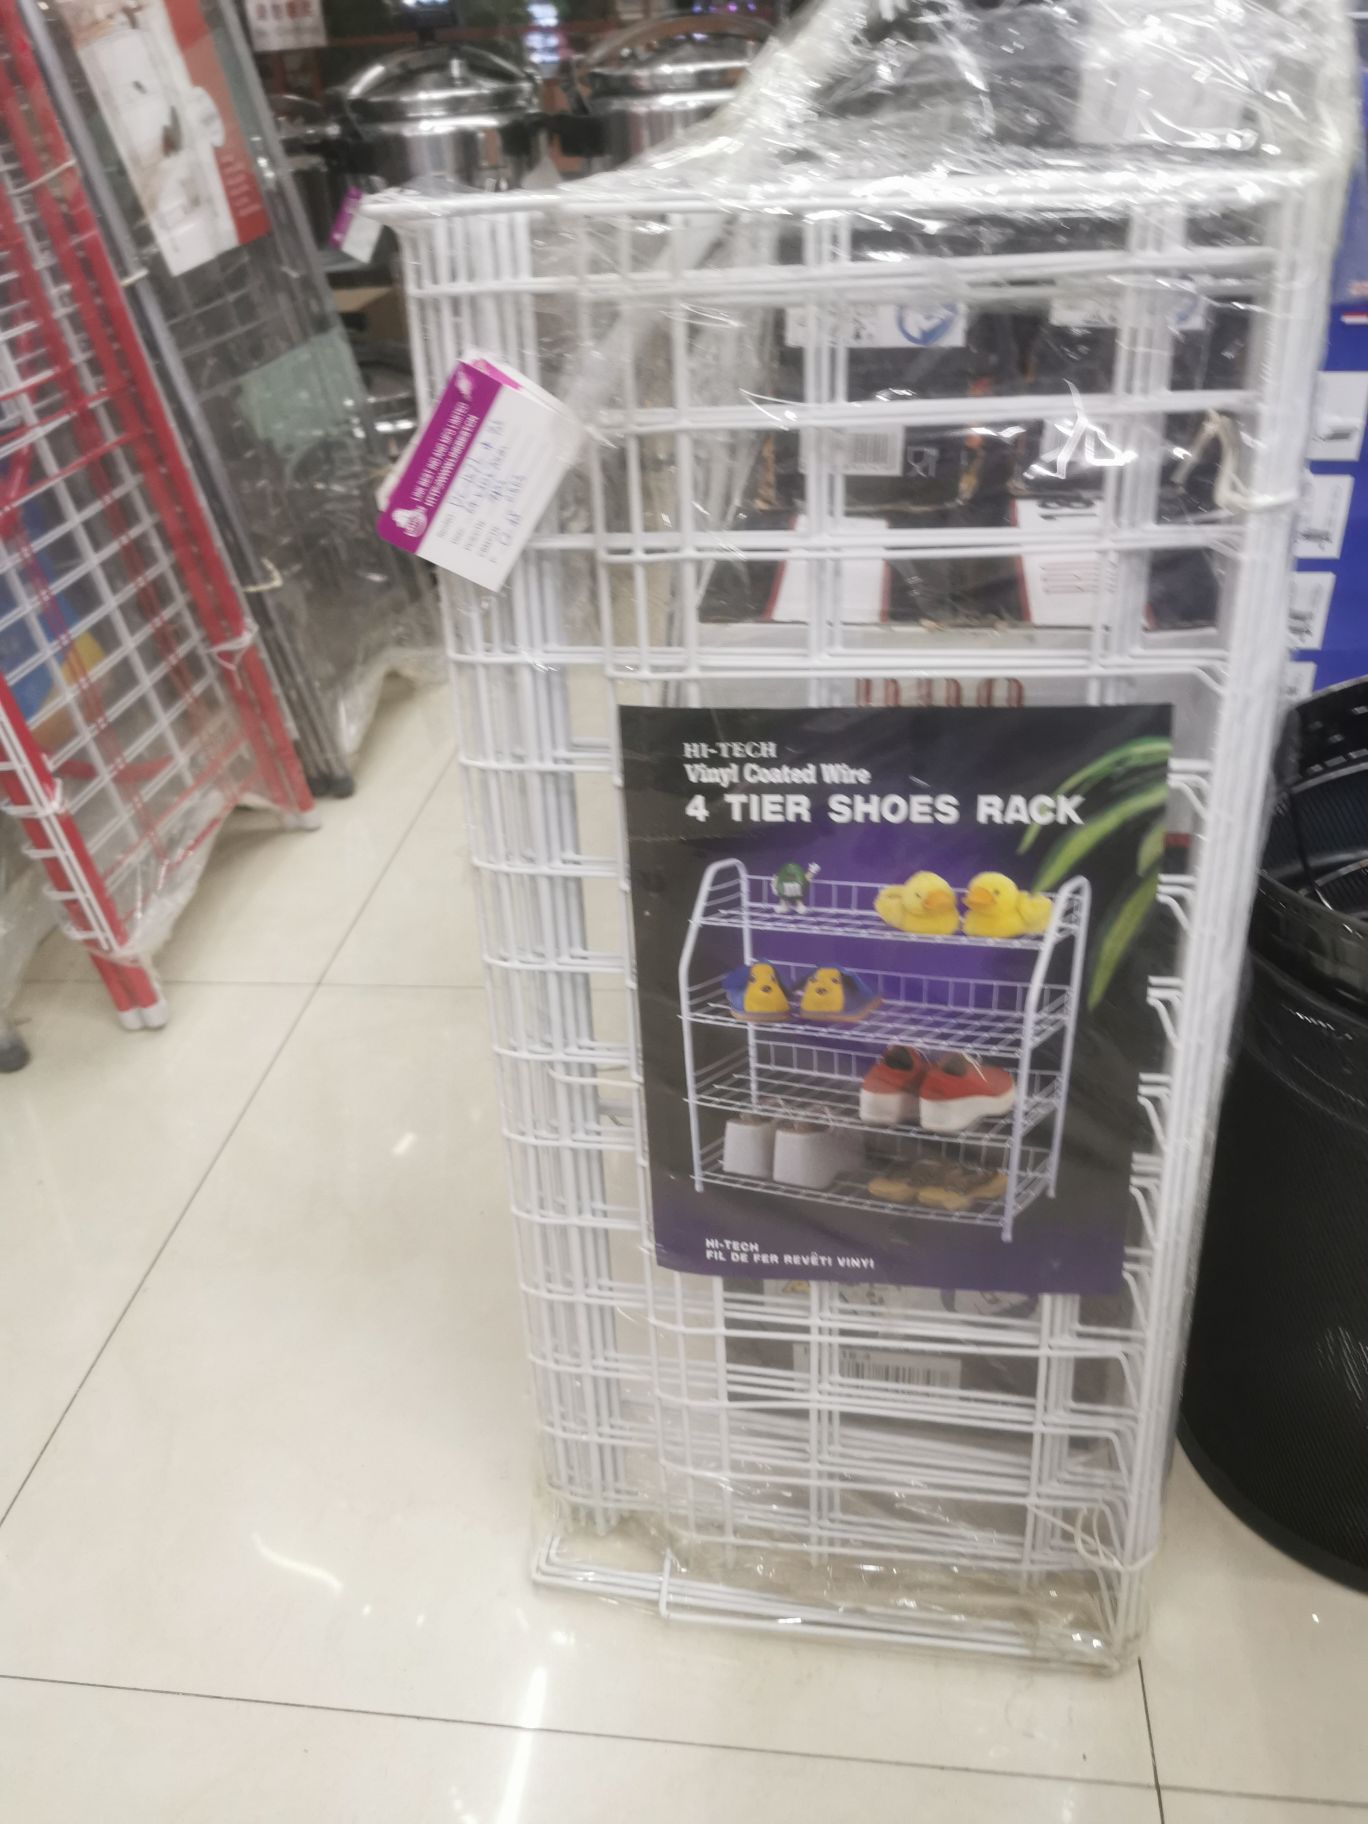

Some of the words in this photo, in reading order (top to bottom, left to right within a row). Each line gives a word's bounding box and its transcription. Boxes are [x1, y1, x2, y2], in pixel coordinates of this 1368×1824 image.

[682, 742, 778, 758] HI-TECH
[683, 763, 740, 788] Vinyl
[743, 763, 818, 785] Coated
[820, 763, 872, 785] Wire
[685, 794, 710, 822] 4
[724, 794, 811, 823] TIER
[827, 794, 960, 824] SHOES
[976, 795, 1085, 825] RACK
[706, 1250, 727, 1262] FIL
[730, 1251, 749, 1264] DE
[753, 1253, 780, 1265] FER
